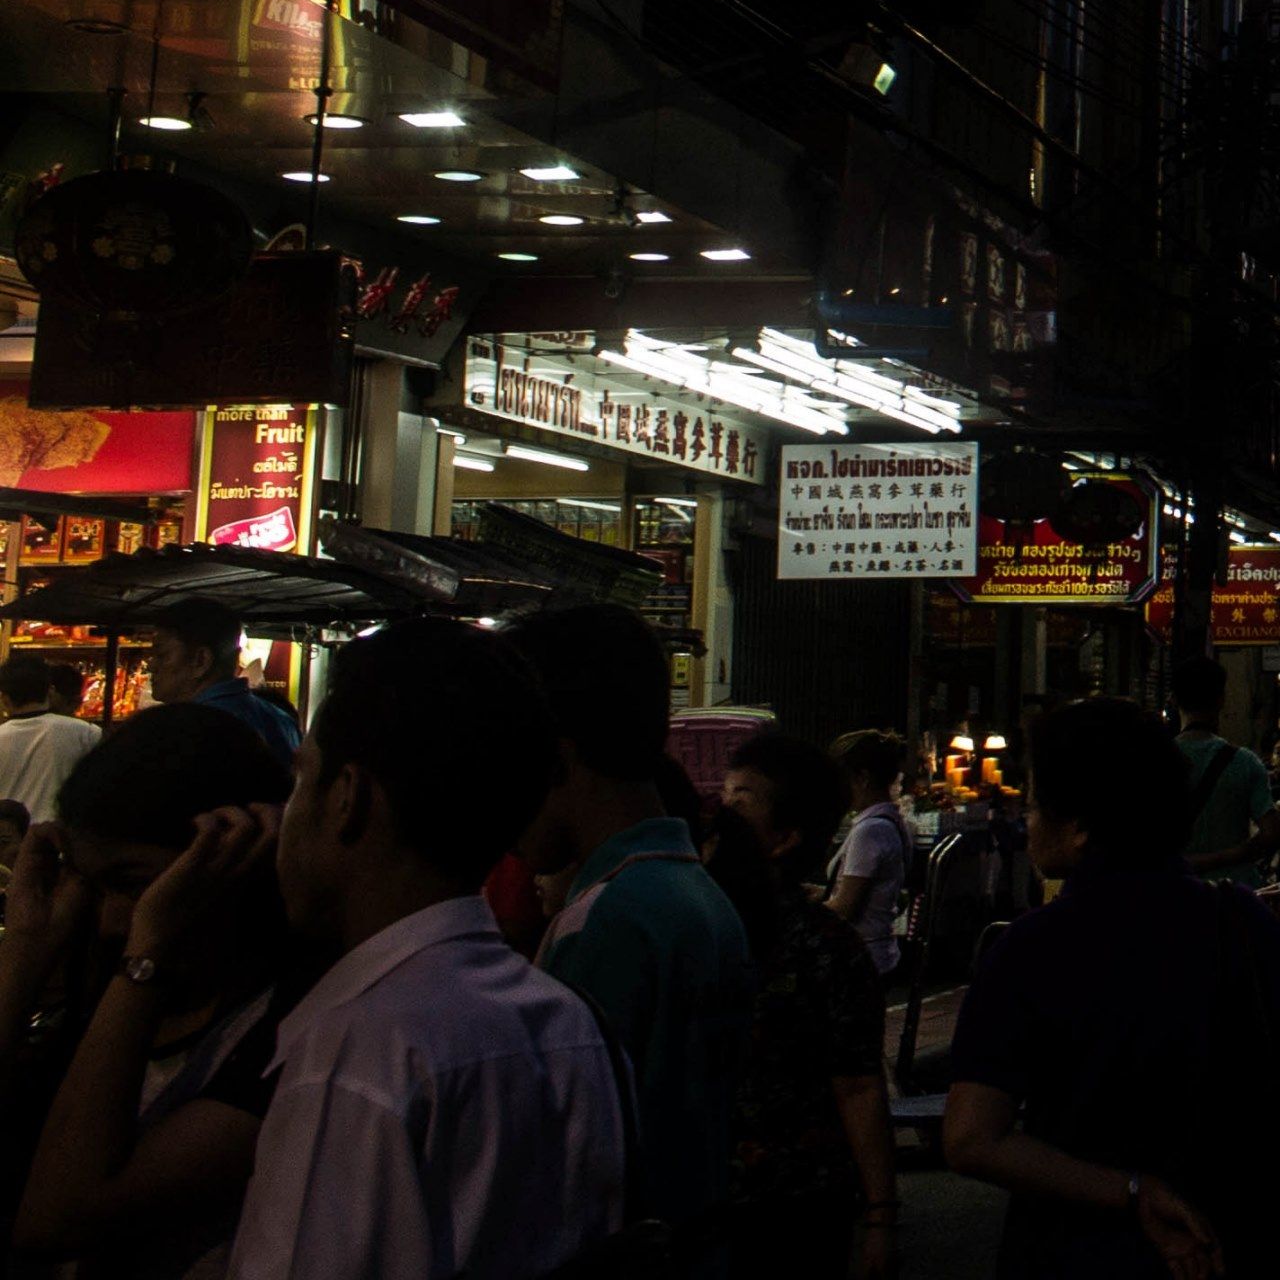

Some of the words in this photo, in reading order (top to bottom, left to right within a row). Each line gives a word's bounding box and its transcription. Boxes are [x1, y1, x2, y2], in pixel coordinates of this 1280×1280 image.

[216, 410, 253, 422] more
[256, 409, 288, 421] than
[256, 423, 304, 444] Fruit
[787, 459, 829, 479] หจก.
